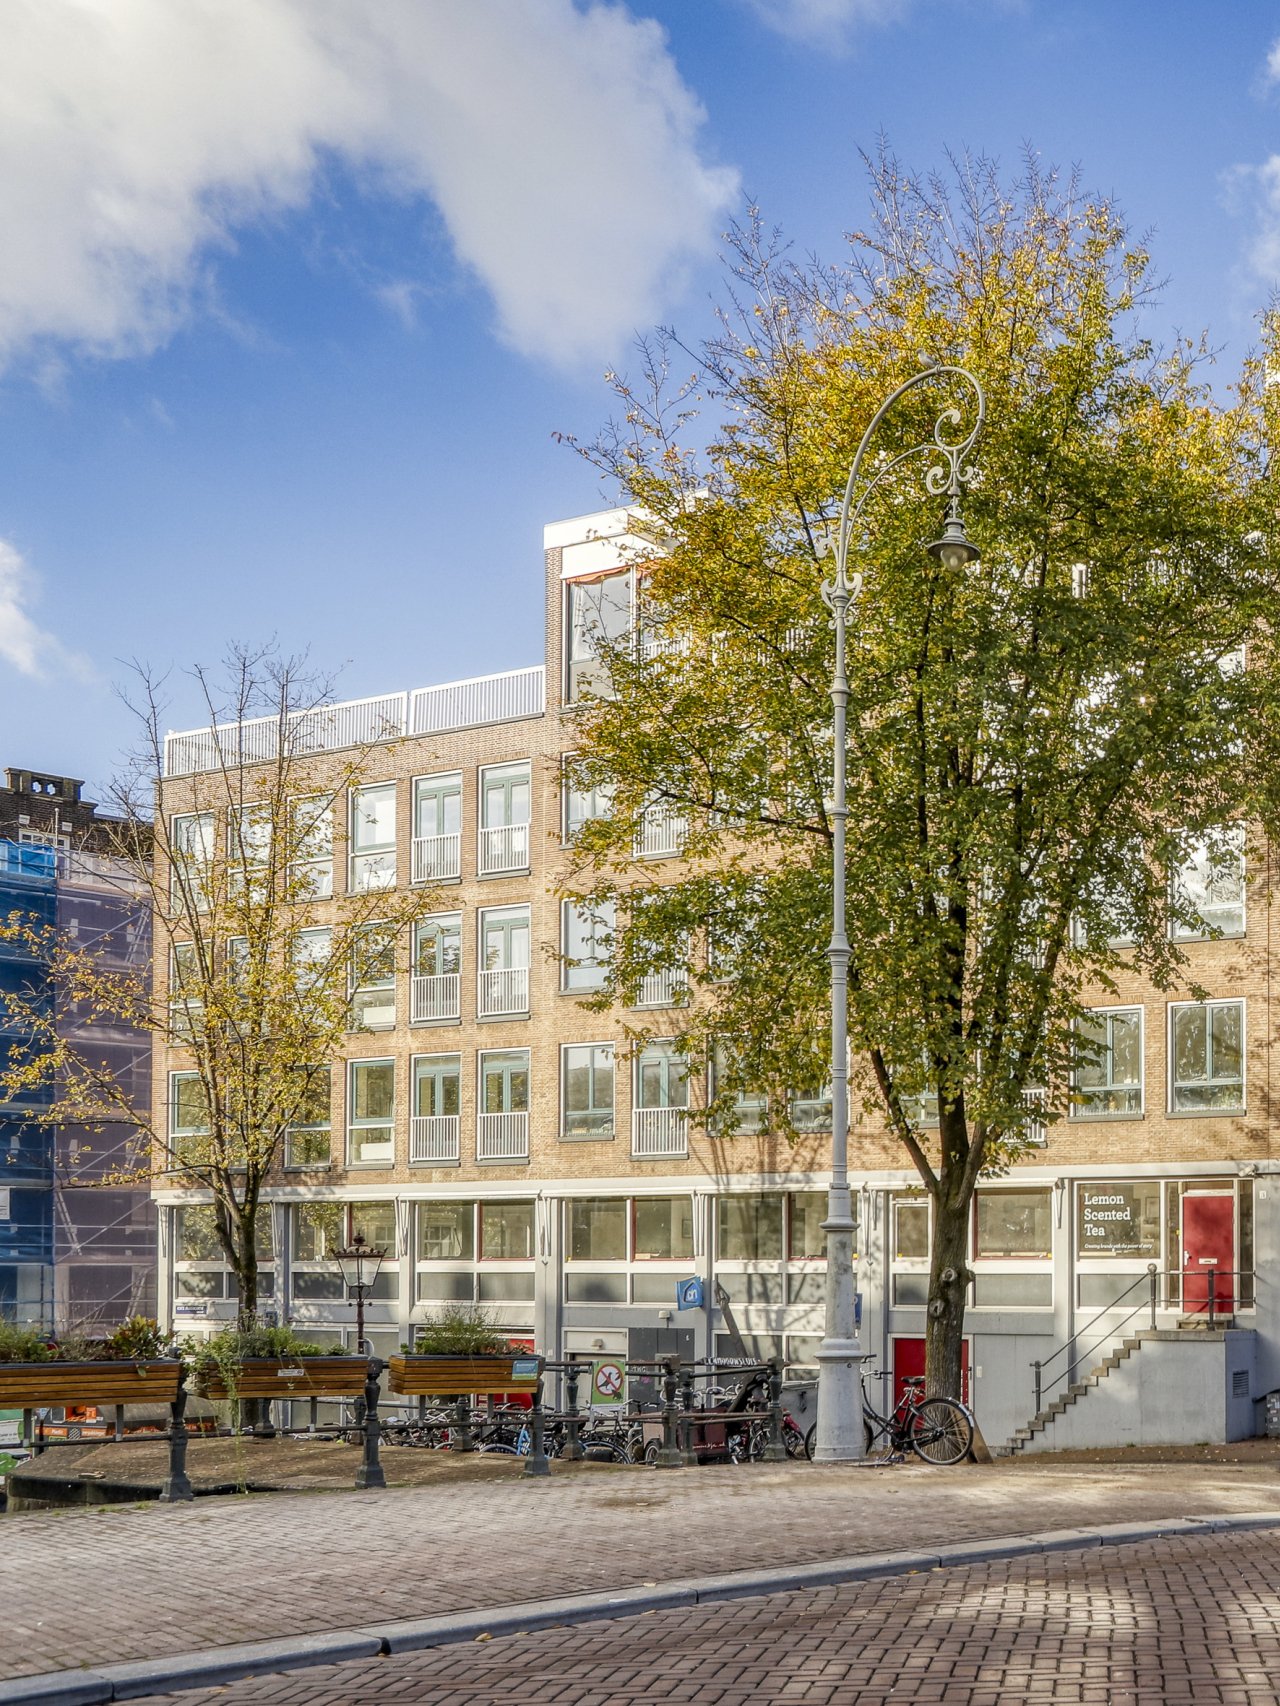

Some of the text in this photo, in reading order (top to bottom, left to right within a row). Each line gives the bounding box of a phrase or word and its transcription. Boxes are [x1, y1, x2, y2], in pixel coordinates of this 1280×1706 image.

[1084, 1193, 1124, 1205] Lemon
[1084, 1207, 1131, 1220] Scented
[1084, 1223, 1105, 1236] Tea
